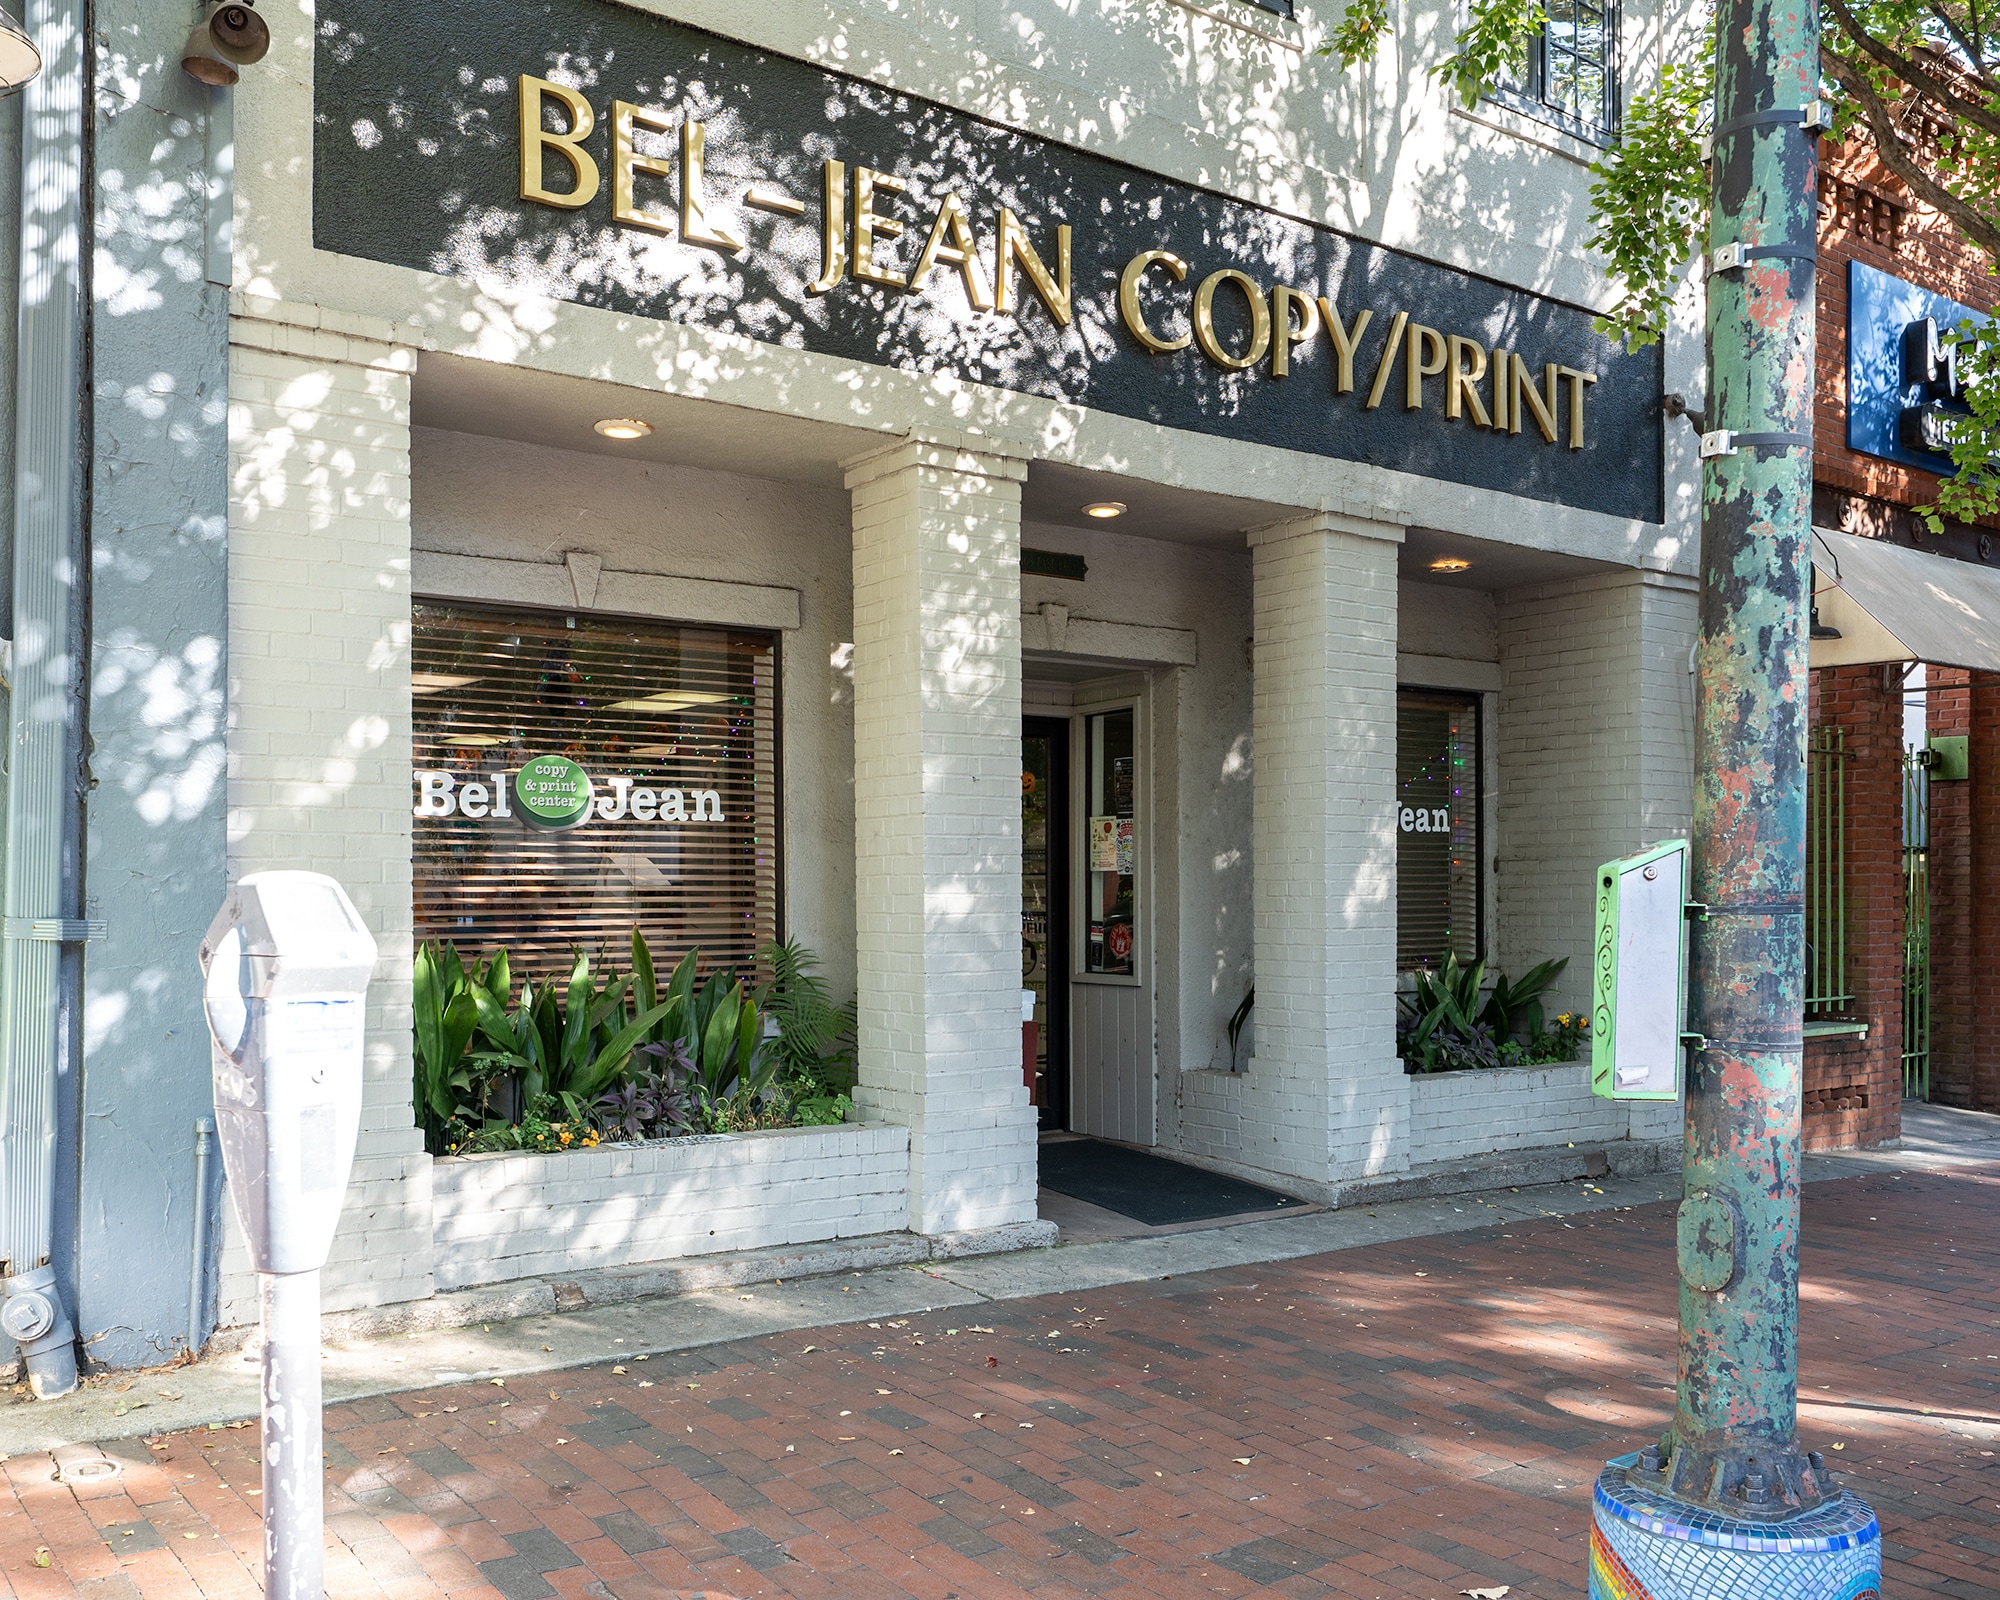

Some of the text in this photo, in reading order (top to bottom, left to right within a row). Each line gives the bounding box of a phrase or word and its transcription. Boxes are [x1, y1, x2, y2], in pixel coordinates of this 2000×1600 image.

[518, 73, 1598, 450] BEL-JEAN COPY/PRINT
[535, 765, 569, 778] copy
[413, 770, 725, 822] Bel Jean
[524, 778, 577, 793] & print
[530, 795, 576, 807] center
[1397, 801, 1450, 832] ean
